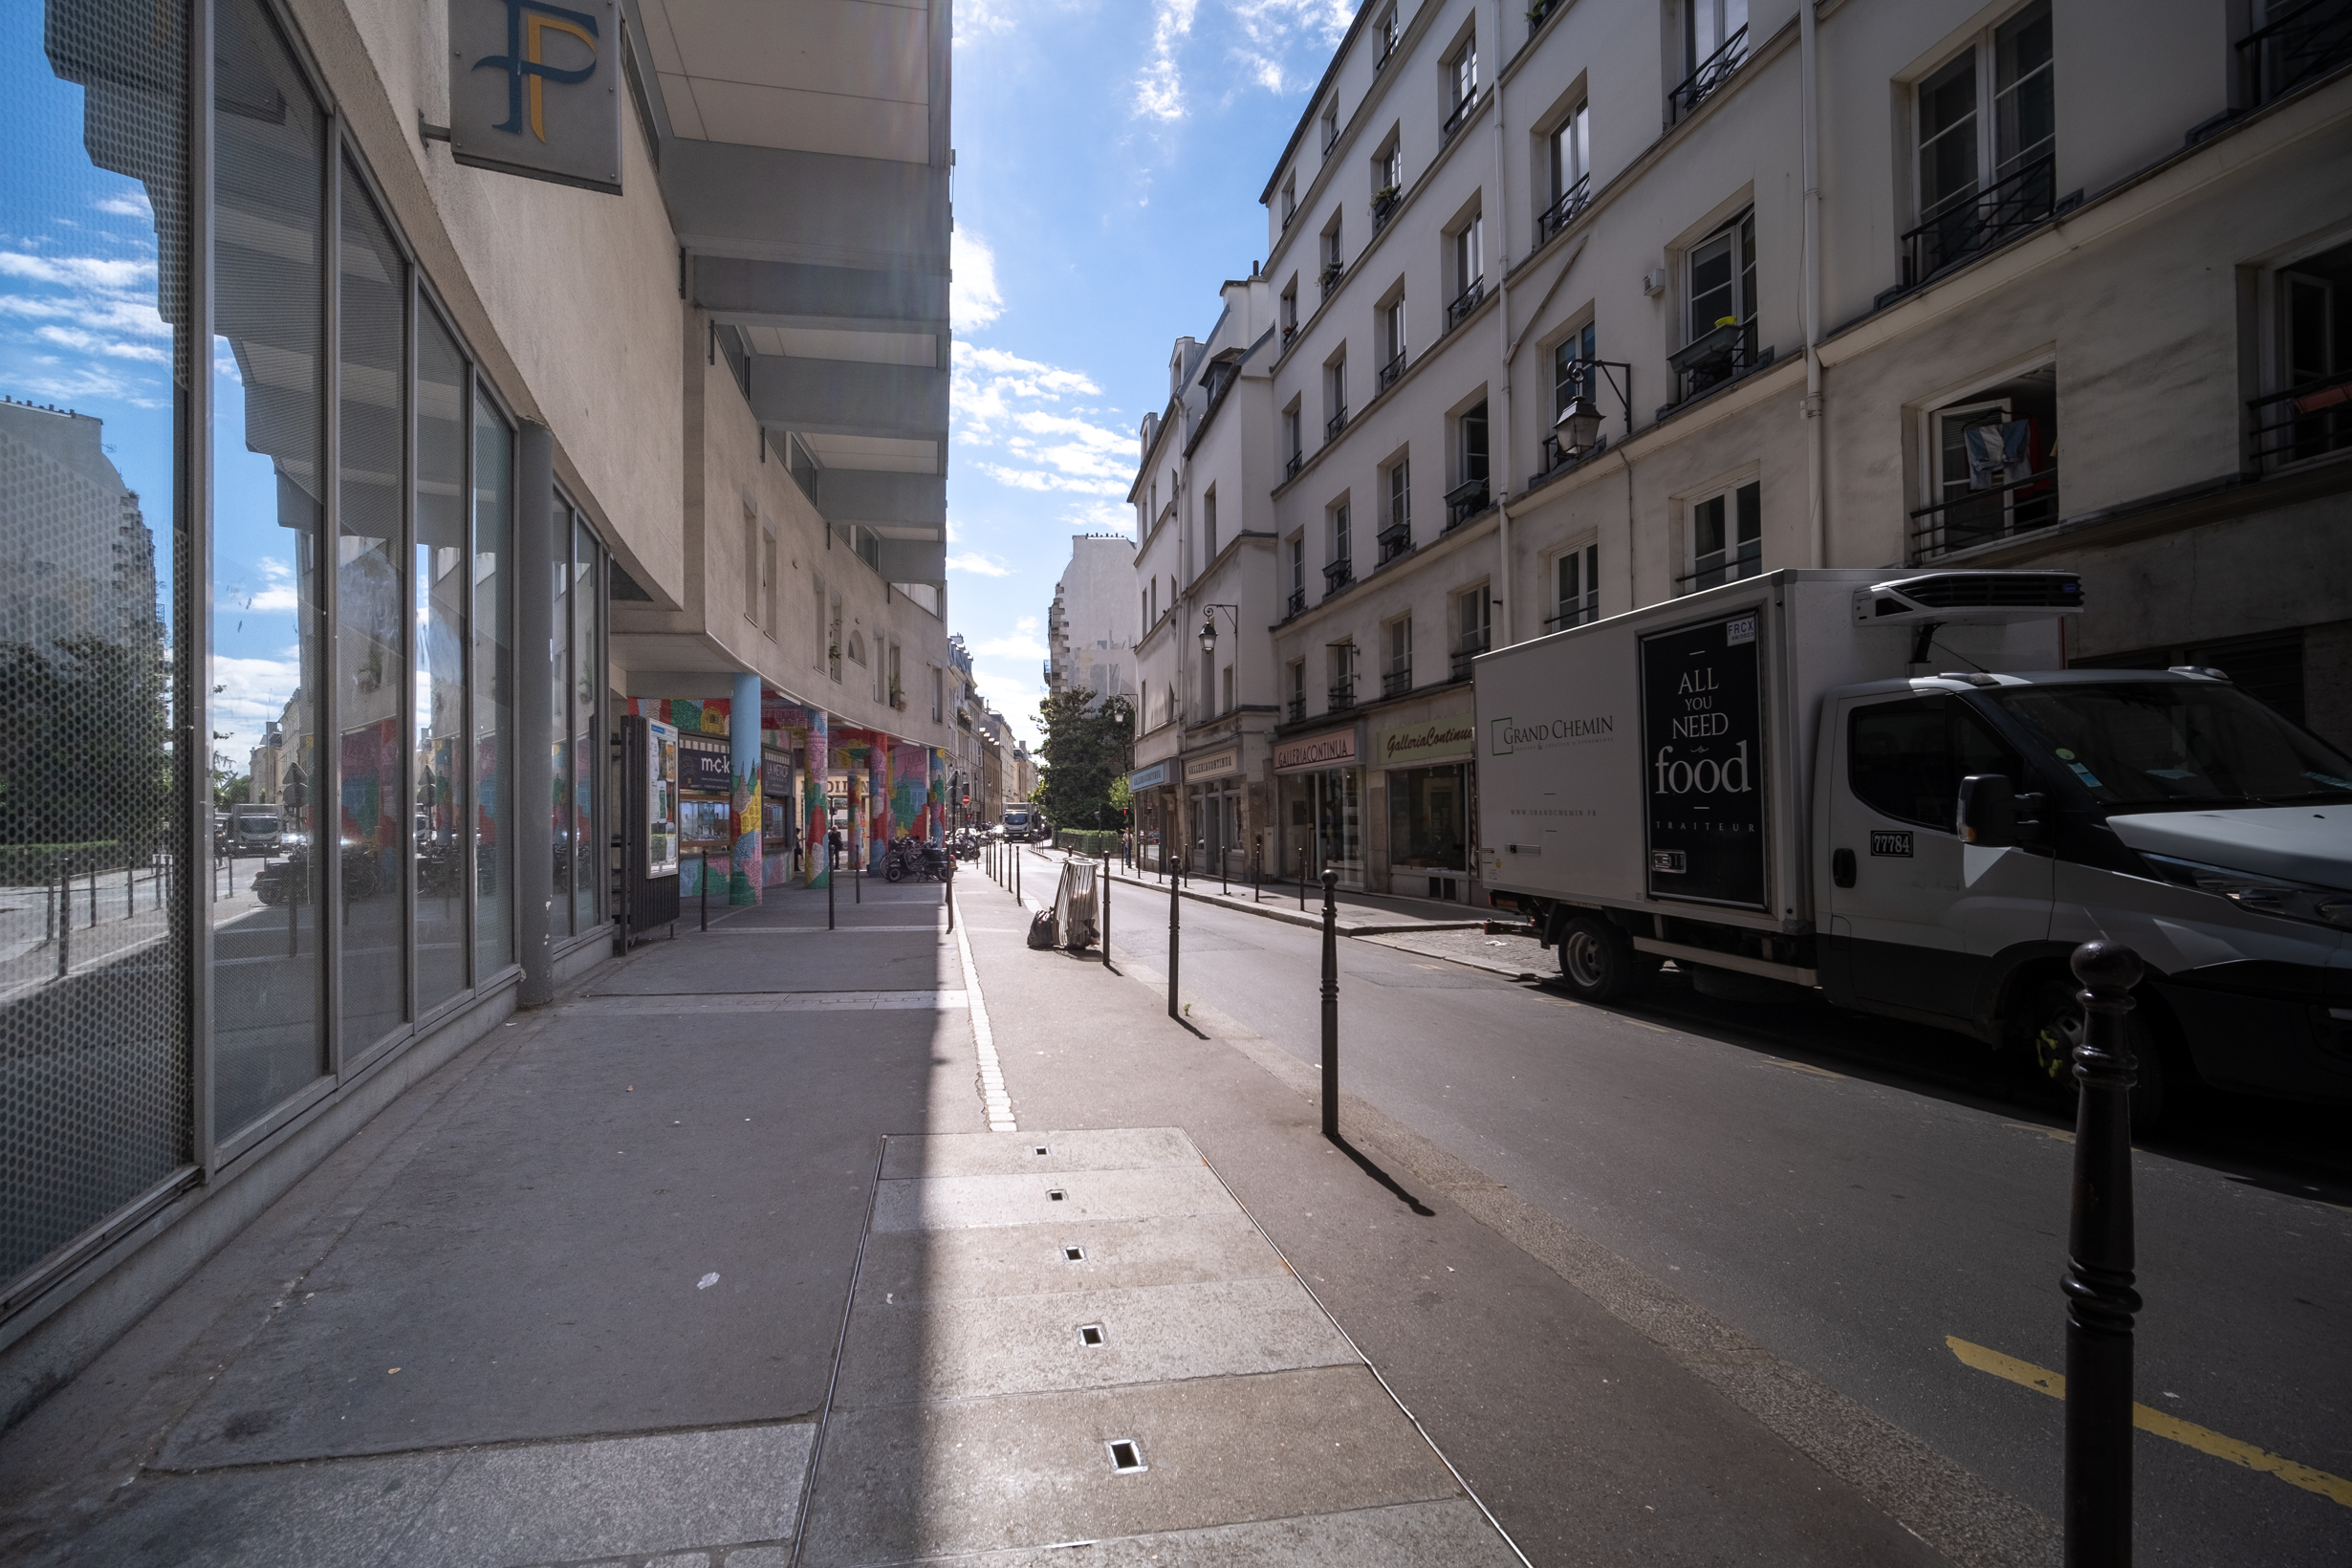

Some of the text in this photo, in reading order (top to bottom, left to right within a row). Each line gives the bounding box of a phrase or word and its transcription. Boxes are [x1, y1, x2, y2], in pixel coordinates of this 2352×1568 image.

[1728, 620, 1753, 636] FRCX
[1678, 666, 1719, 695] ALL
[1685, 695, 1712, 711] YOU
[1503, 715, 1613, 745] GRAND CHEMIN
[1672, 711, 1729, 739] NEED
[1278, 738, 1348, 767] GALLERIACONTINUA
[1537, 742, 1543, 751] &
[1655, 739, 1753, 795] food
[1655, 820, 1755, 833] TRAITEUR
[1874, 834, 1910, 853] 77784
